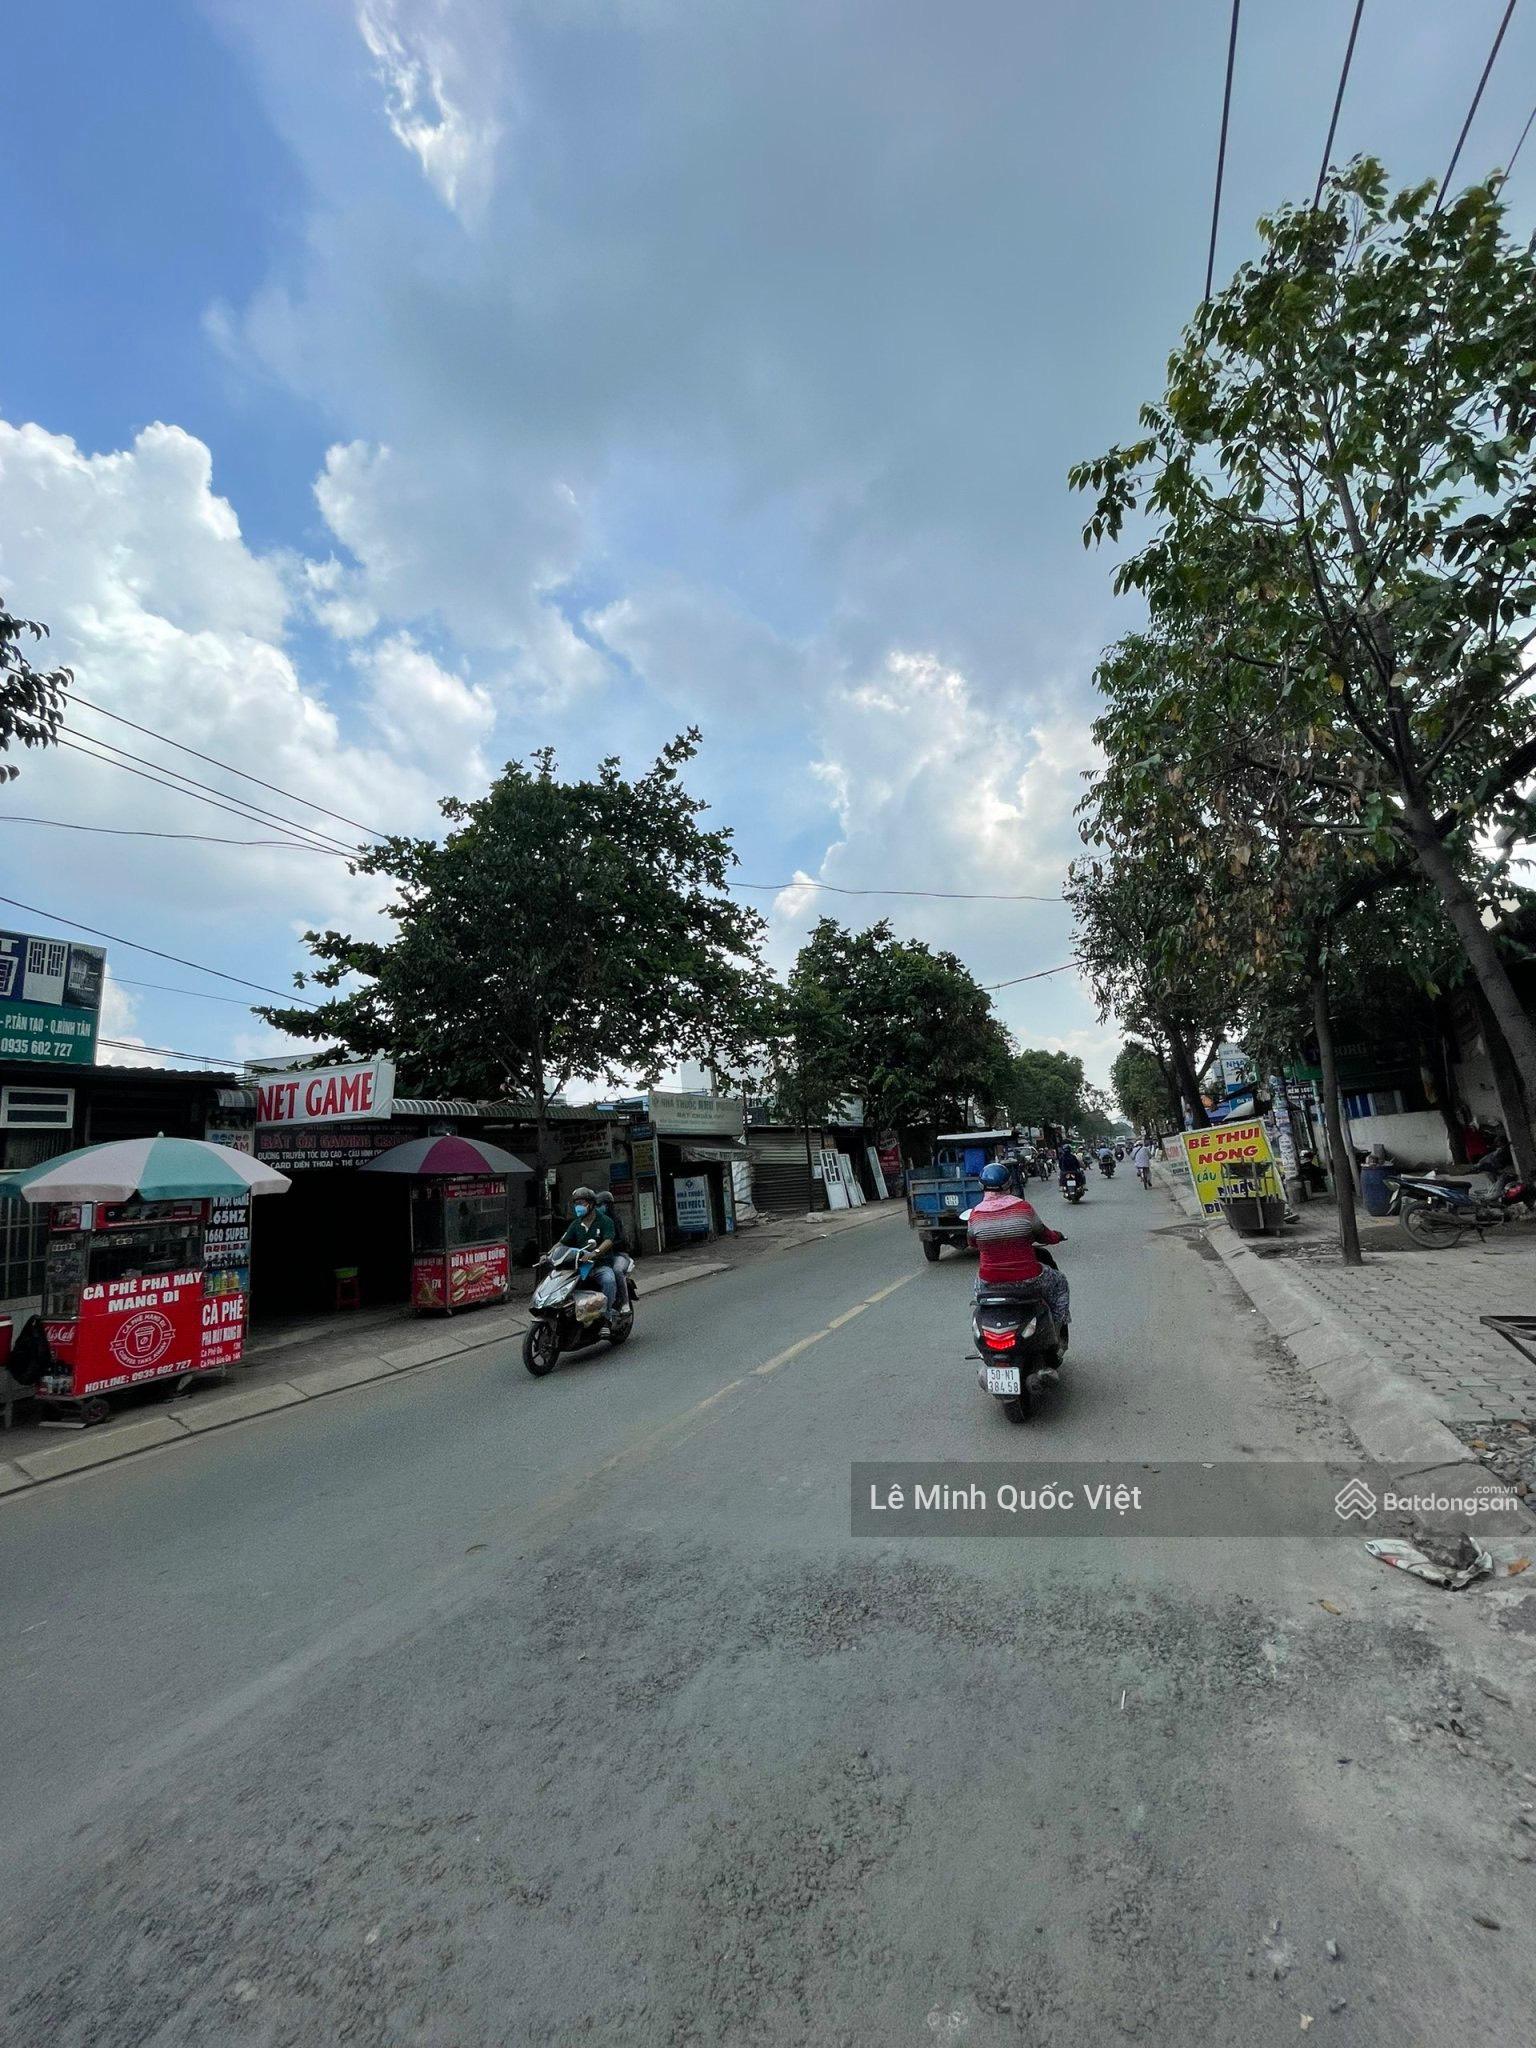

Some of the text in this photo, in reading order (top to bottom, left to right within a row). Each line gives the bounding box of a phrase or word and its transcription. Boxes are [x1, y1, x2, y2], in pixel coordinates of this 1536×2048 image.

[5, 1013, 28, 1031] P.TÂN
[29, 1017, 44, 1034] TẠO
[77, 1020, 91, 1037] TÂN
[0, 1037, 73, 1057] 0935 602 727
[257, 1072, 373, 1122] NET GAME
[1188, 1127, 1260, 1149] BÊ THUI
[331, 1149, 342, 1159] CAO
[1198, 1146, 1258, 1164] NÓNG
[205, 1227, 248, 1243] 1660 SUPER
[206, 1243, 246, 1252] ROBLOX
[83, 1271, 202, 1300] CÀ PHÊ PHA MÁY
[108, 1290, 180, 1313] MANG ĐI
[202, 1294, 243, 1326] CÀ PHÊ
[85, 1375, 130, 1392] HOTLINE:
[132, 1368, 154, 1381] 0935
[176, 1360, 192, 1368] 727
